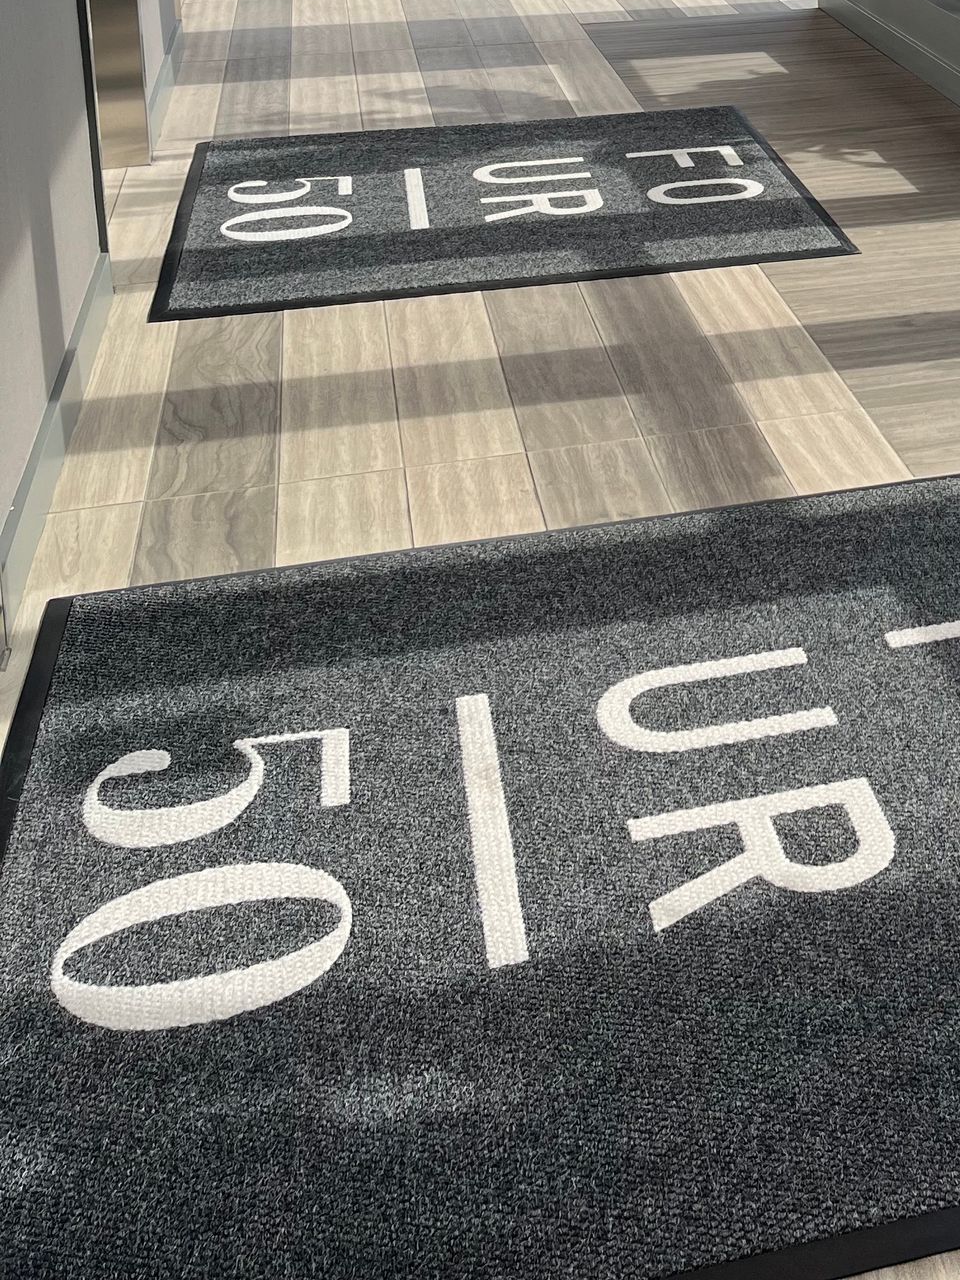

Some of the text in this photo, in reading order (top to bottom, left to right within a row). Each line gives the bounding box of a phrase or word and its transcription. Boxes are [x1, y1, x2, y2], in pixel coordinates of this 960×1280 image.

[220, 175, 354, 243] 50
[471, 156, 605, 224] UR
[626, 146, 765, 206] FO
[593, 646, 898, 934] UR
[49, 726, 354, 1031] 50
